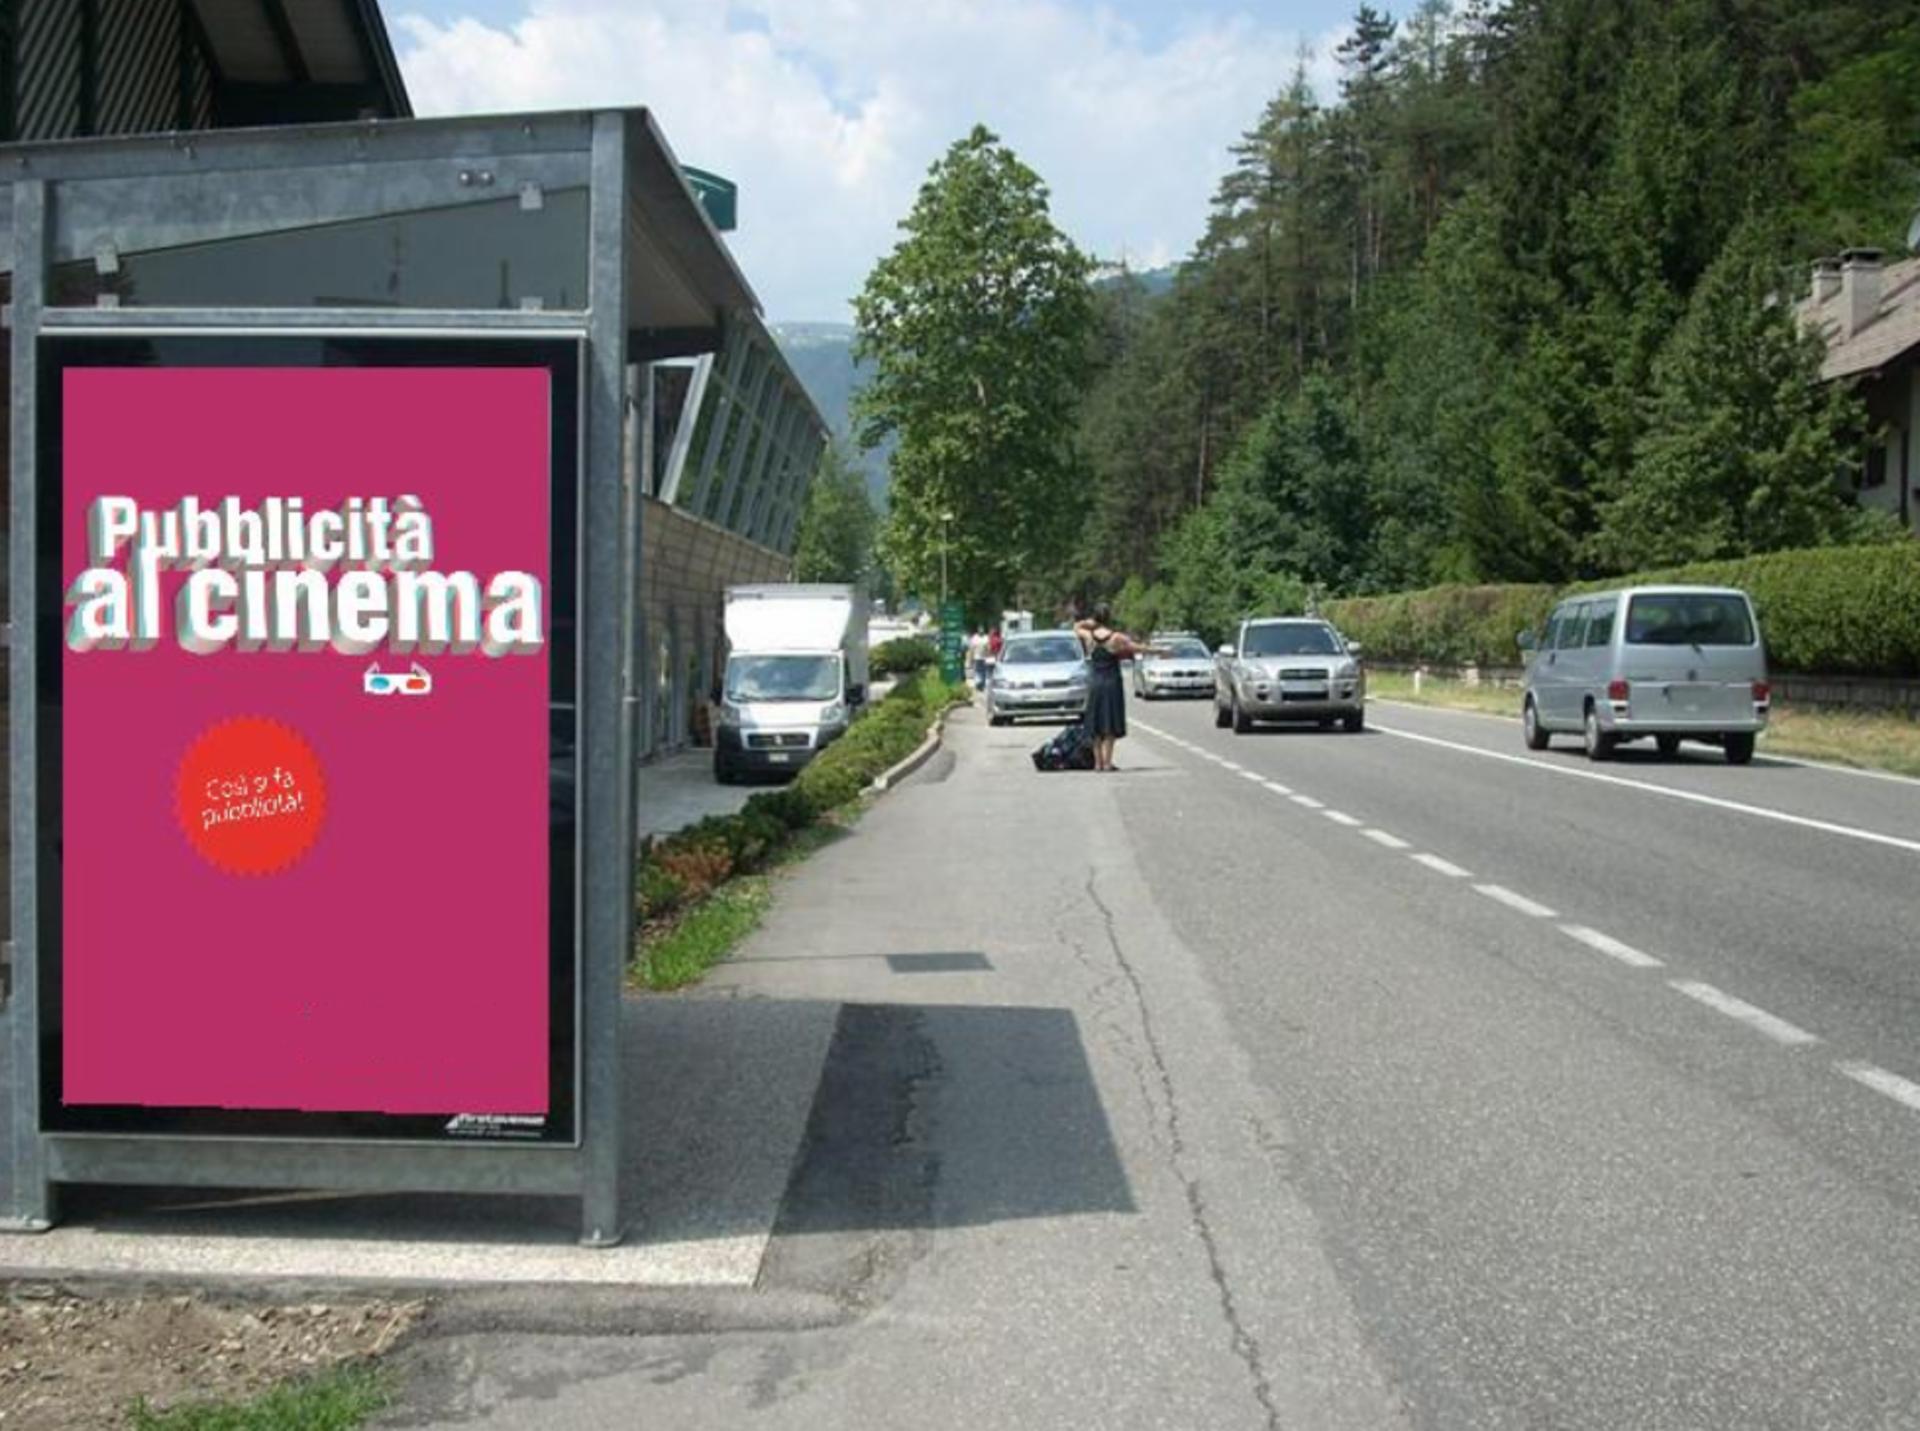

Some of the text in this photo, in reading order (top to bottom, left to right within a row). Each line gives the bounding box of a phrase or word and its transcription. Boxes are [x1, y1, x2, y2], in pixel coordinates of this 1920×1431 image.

[91, 494, 434, 566] Pubblicità
[67, 546, 545, 656] al cinema
